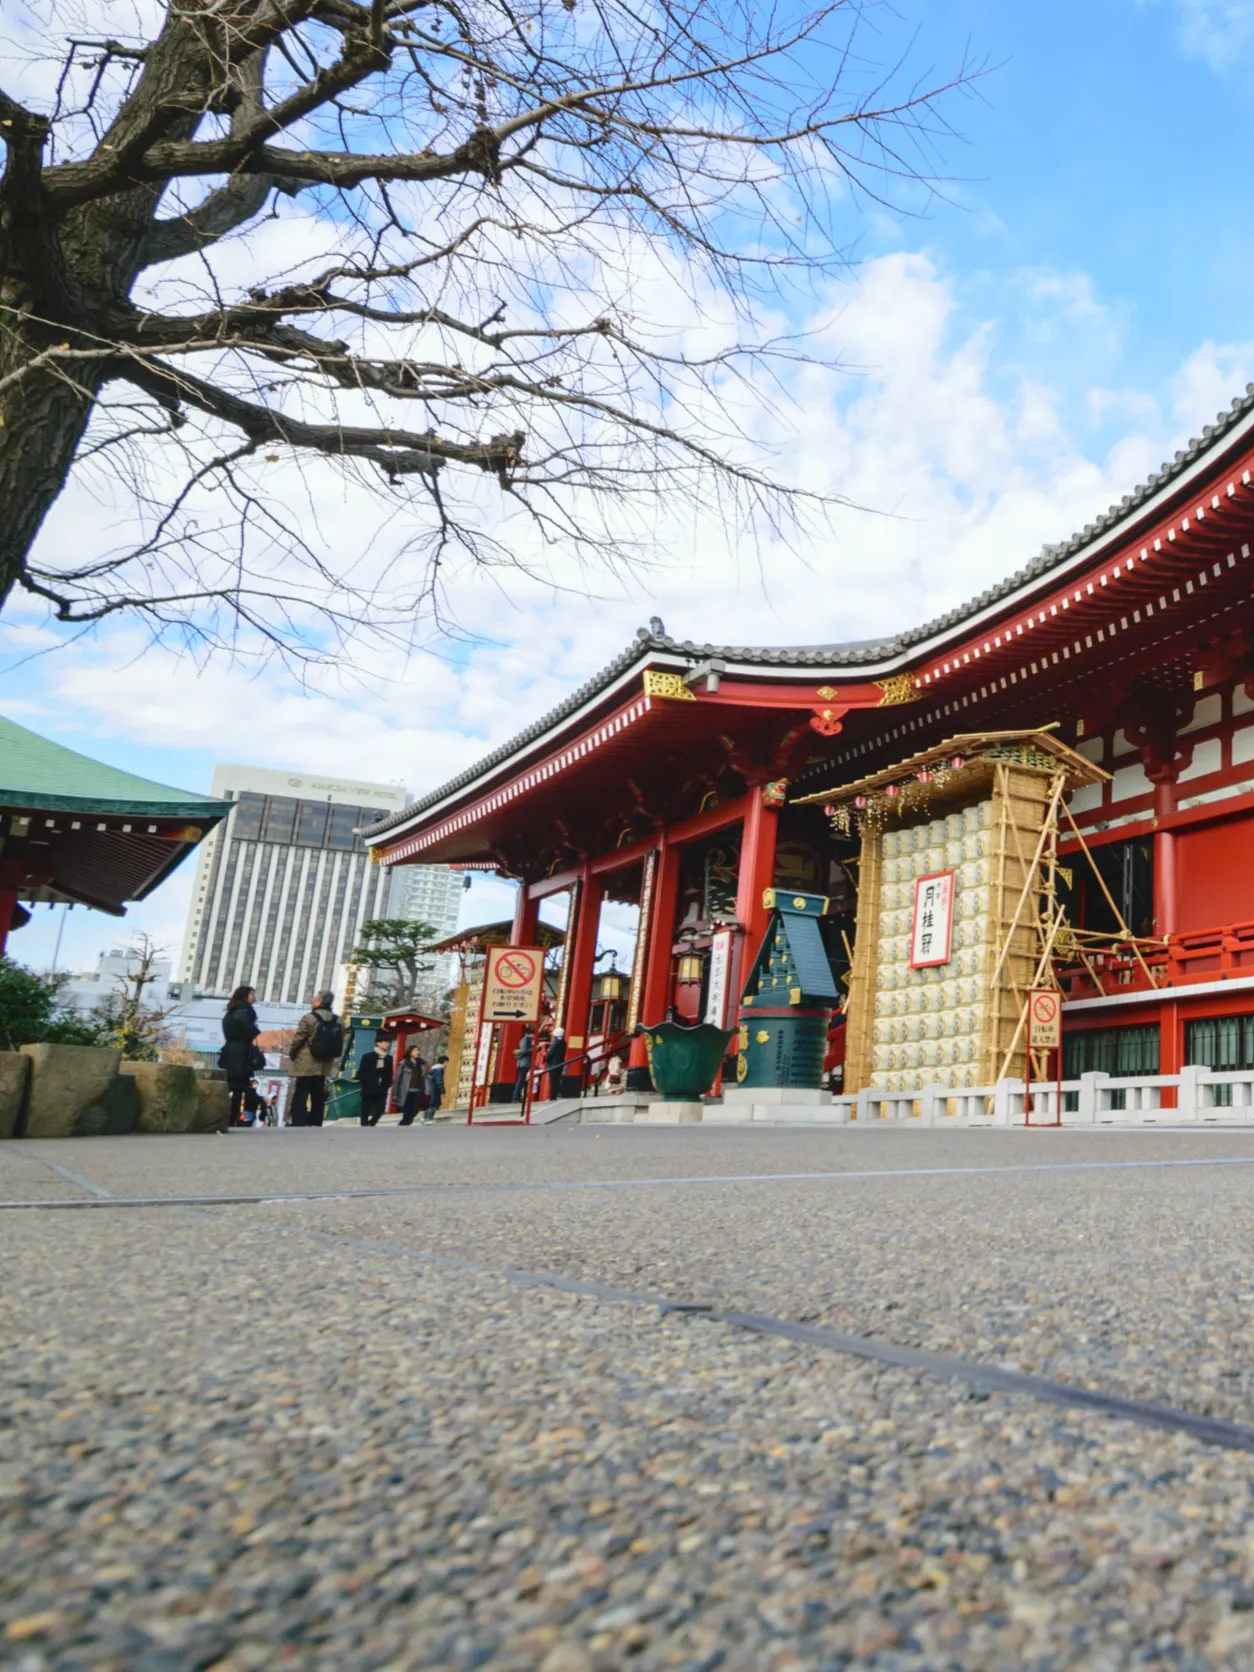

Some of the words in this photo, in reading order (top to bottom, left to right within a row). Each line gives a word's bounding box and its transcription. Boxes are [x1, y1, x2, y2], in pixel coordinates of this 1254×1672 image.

[920, 885, 936, 955] 月桂冠
[1034, 1025, 1054, 1033] 自転車
